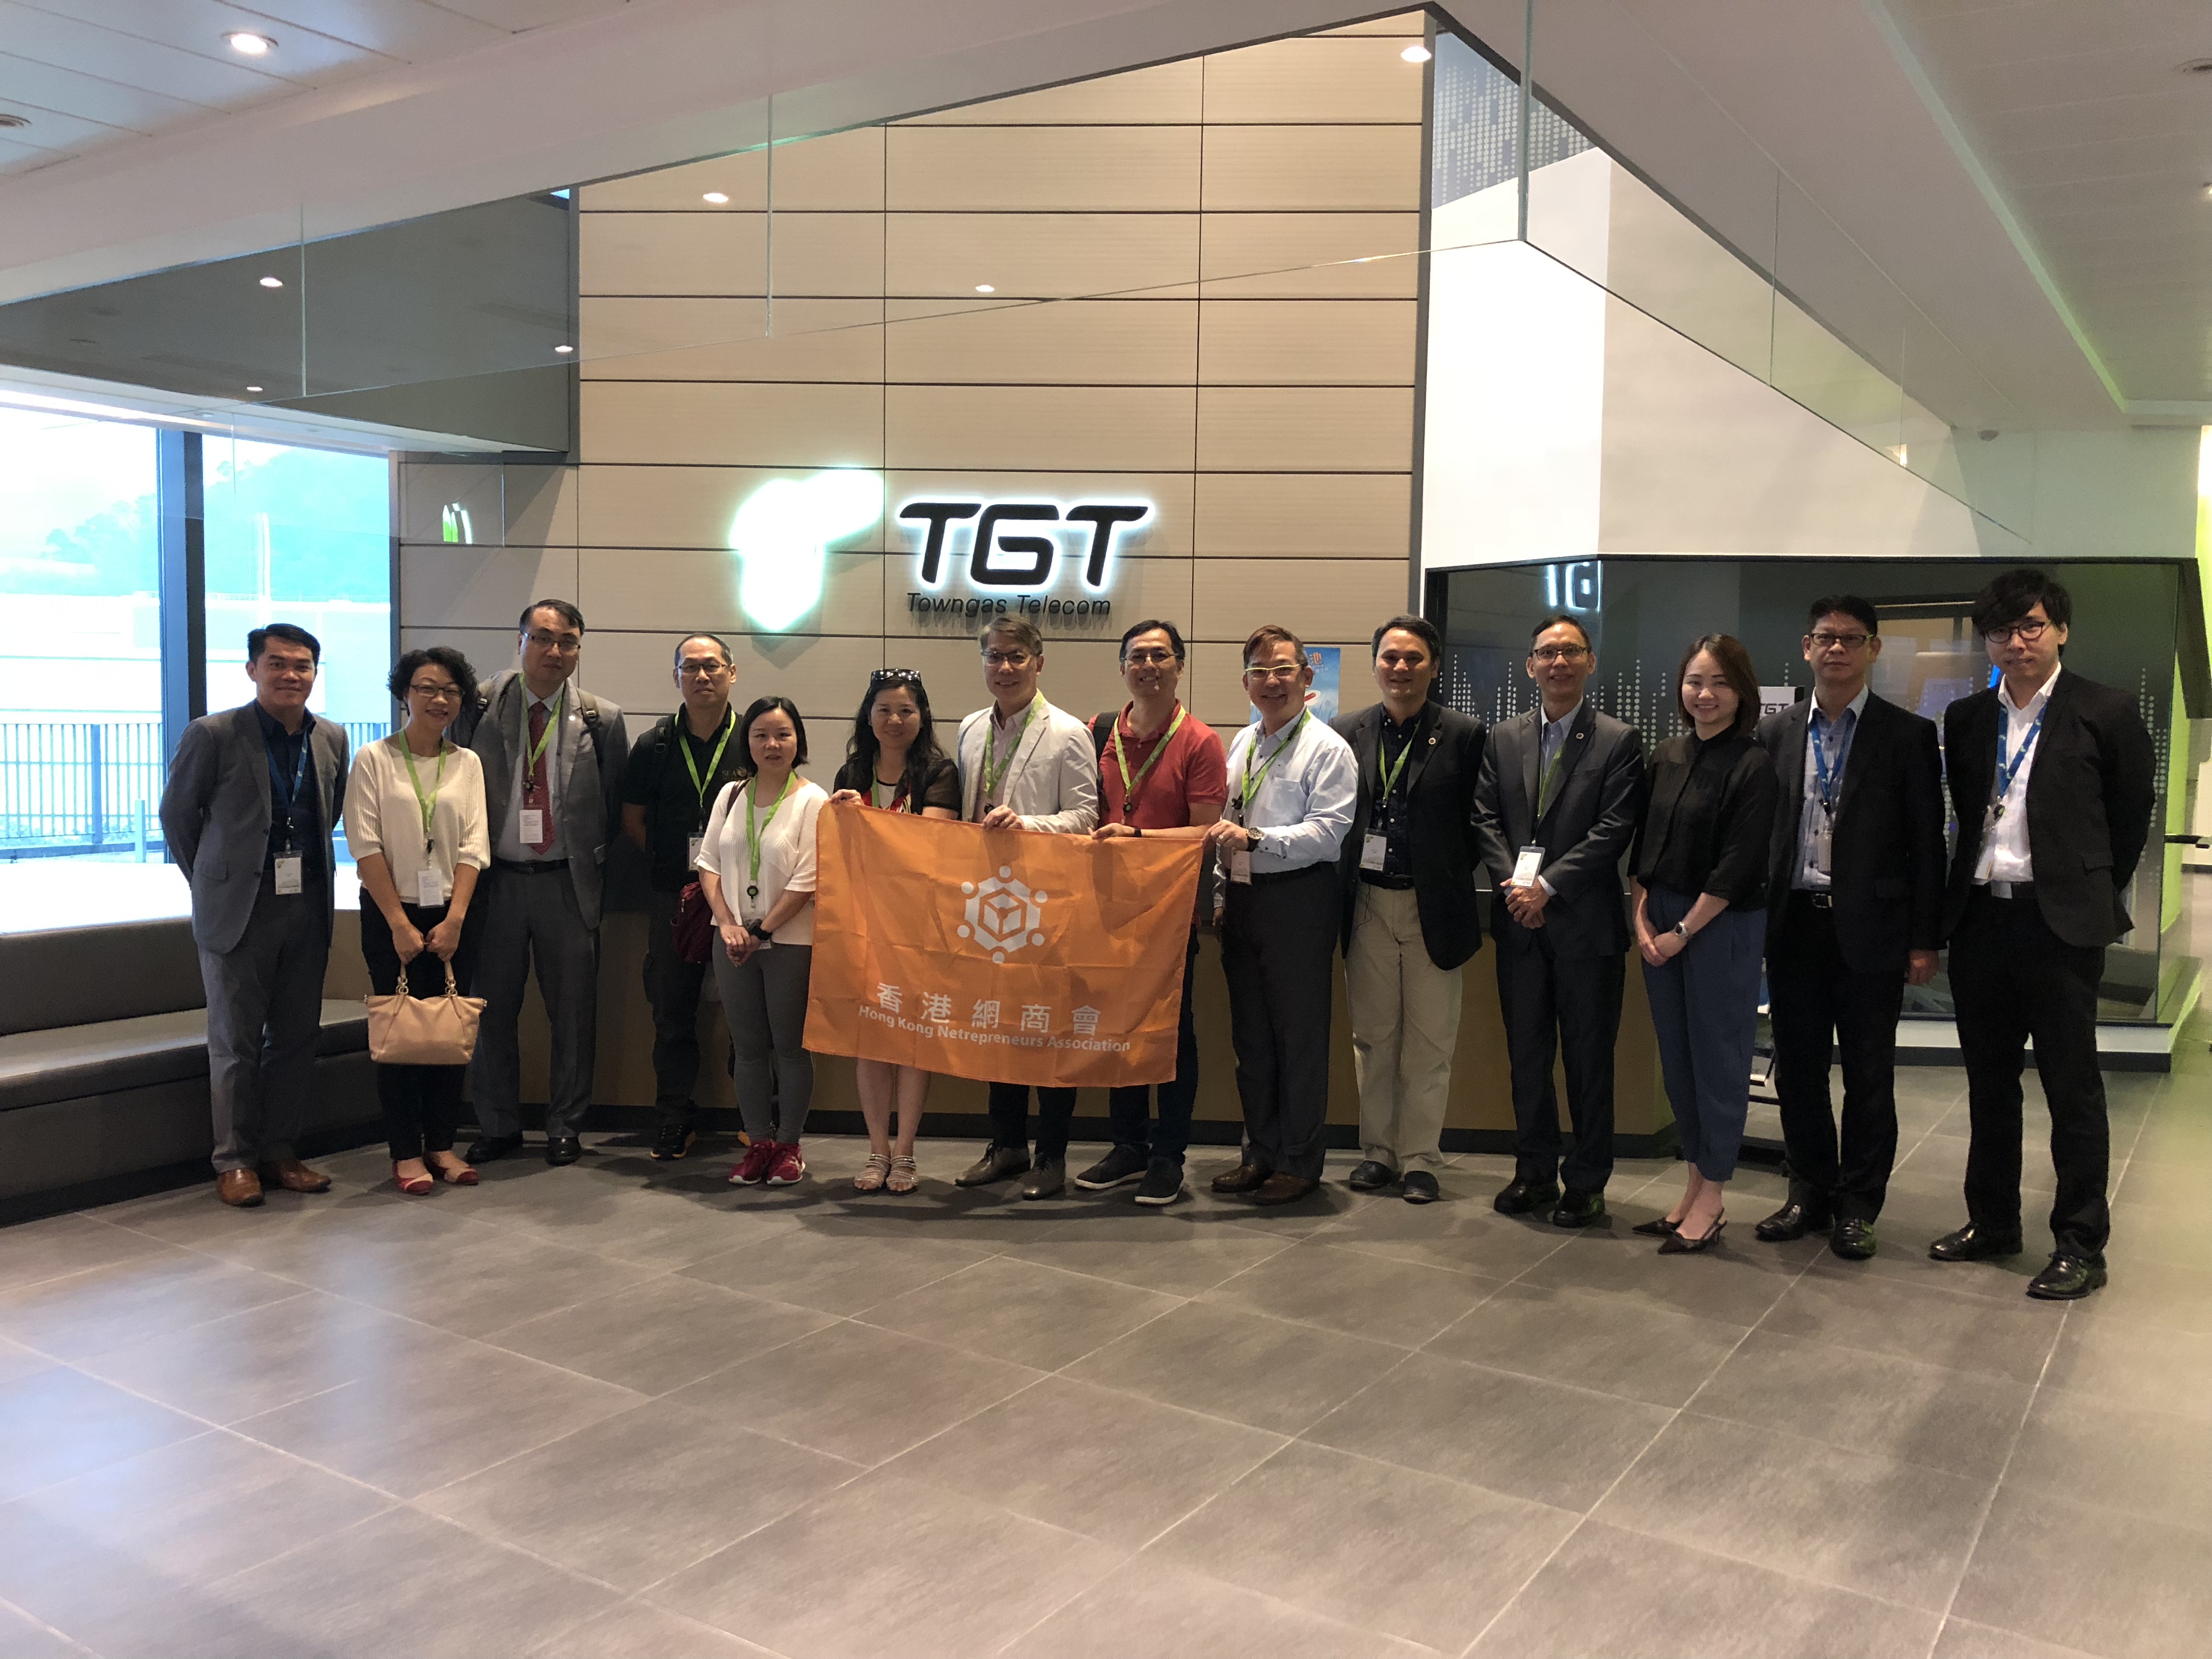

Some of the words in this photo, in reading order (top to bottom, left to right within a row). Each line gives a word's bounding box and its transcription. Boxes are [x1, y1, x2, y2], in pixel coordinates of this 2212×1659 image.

[899, 502, 1149, 587] TGT
[907, 592, 1007, 617] Towngas
[1017, 595, 1111, 614] Telecom
[858, 1005, 895, 1028] Hong
[898, 1017, 934, 1038] Kong
[937, 1024, 1043, 1047] Netrepreneurs
[1047, 1036, 1131, 1052] Association
[877, 982, 1102, 1036] 香港網商會
